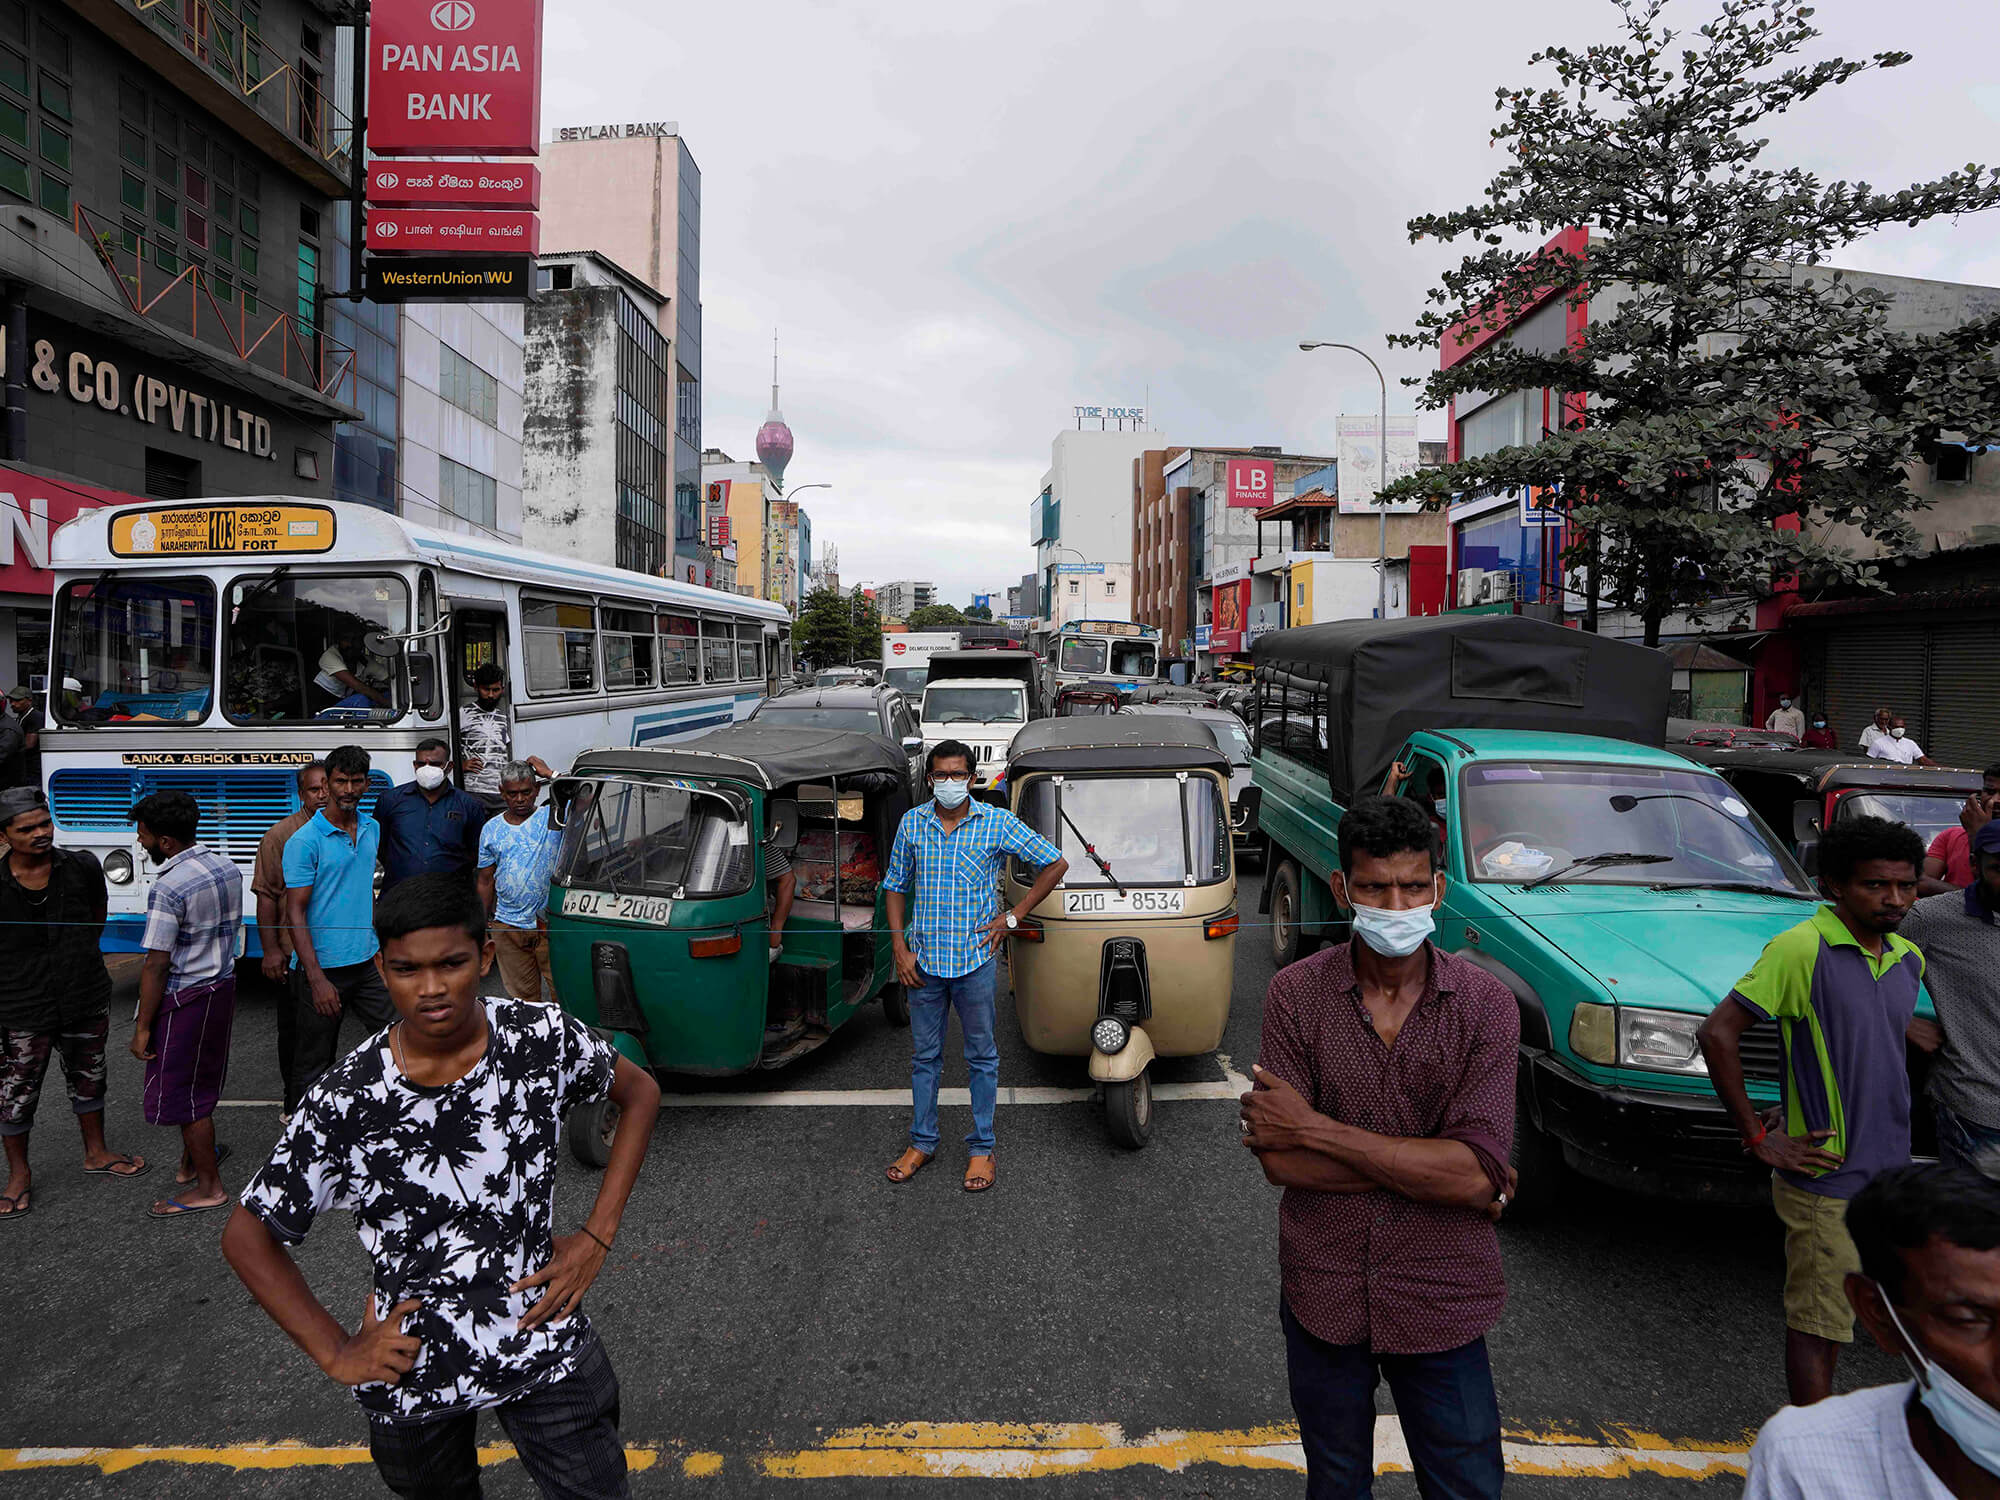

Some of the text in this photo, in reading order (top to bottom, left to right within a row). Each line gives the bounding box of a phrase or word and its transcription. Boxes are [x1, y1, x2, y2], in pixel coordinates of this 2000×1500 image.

[382, 45, 521, 72] PAN ASIA
[407, 94, 492, 120] BANK
[560, 121, 668, 140] SEYLAN BANK
[405, 224, 434, 235] பான்
[382, 271, 483, 284] WesternUnion
[31, 339, 60, 393] &
[1074, 406, 1144, 418] TYRE HOUSE
[1235, 469, 1267, 490] LB
[1235, 491, 1267, 499] FINANCE
[210, 512, 235, 549] 103
[161, 540, 278, 551] NARAHENPITA FORT
[123, 754, 313, 763] LANKA ASHOK LEYLAND
